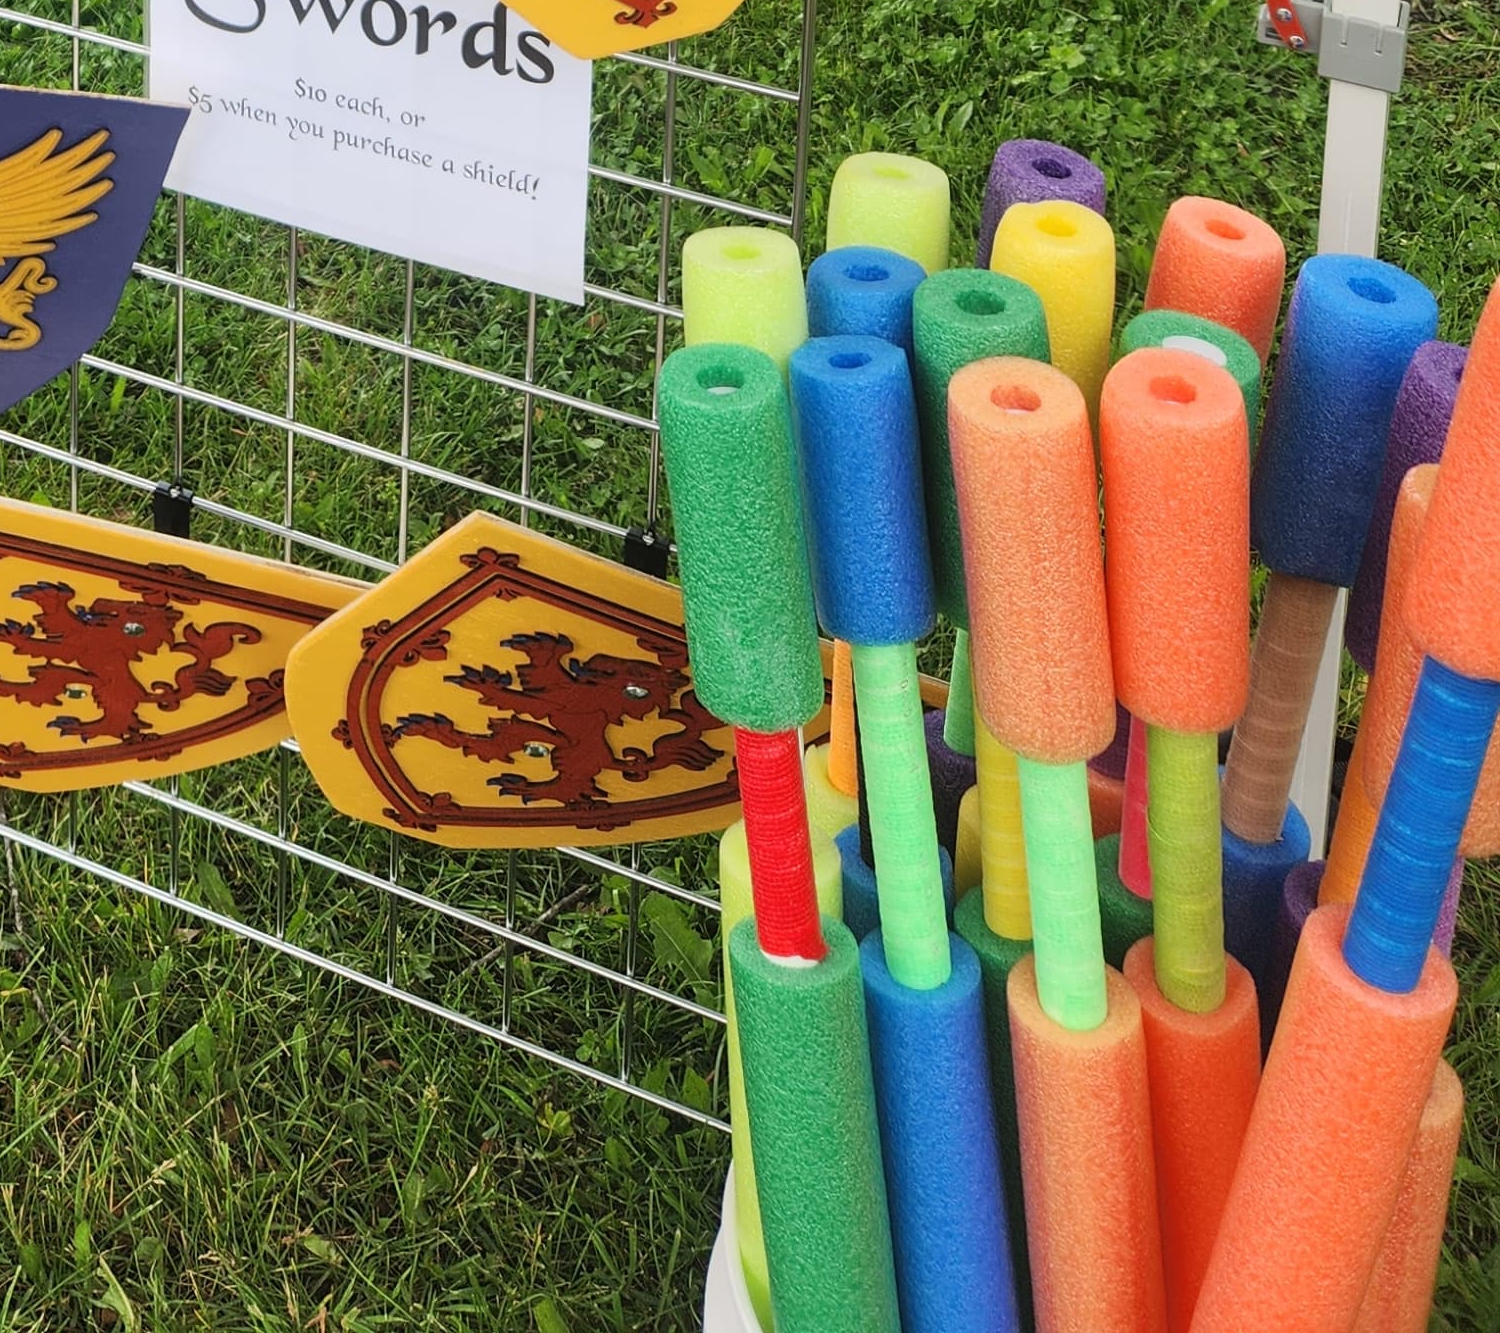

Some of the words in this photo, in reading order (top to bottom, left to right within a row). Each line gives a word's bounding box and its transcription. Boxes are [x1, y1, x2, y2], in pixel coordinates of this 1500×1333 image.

[187, 85, 213, 114] $5
[220, 96, 277, 127] when
[285, 115, 324, 141] you
[332, 125, 433, 169] purchase
[441, 158, 455, 175] a
[462, 161, 540, 200] shield!
[293, 77, 327, 104] $10
[335, 91, 391, 123] each,
[400, 109, 426, 129] or
